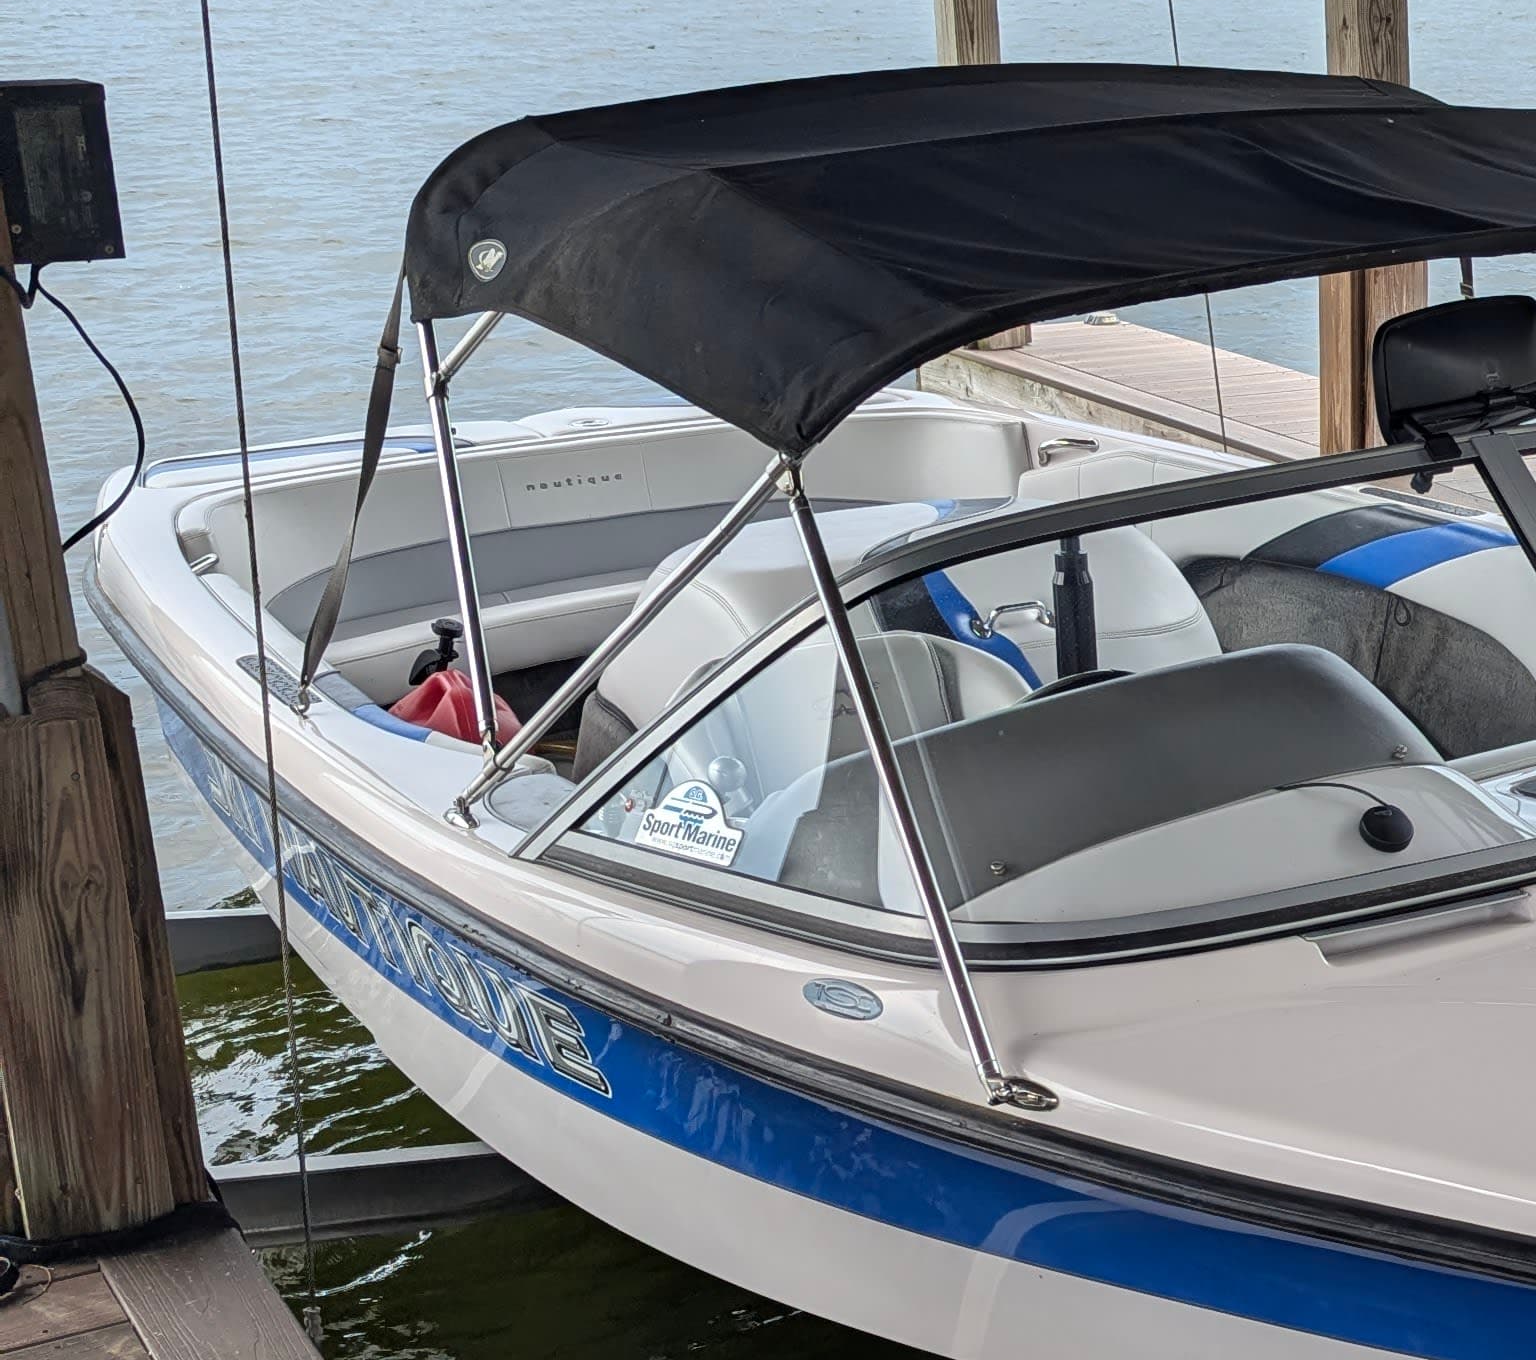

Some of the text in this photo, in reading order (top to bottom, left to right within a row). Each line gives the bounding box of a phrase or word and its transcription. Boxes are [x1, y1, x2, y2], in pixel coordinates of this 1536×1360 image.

[525, 472, 622, 491] nautique
[643, 813, 682, 838] Sport
[682, 823, 737, 853] Marine
